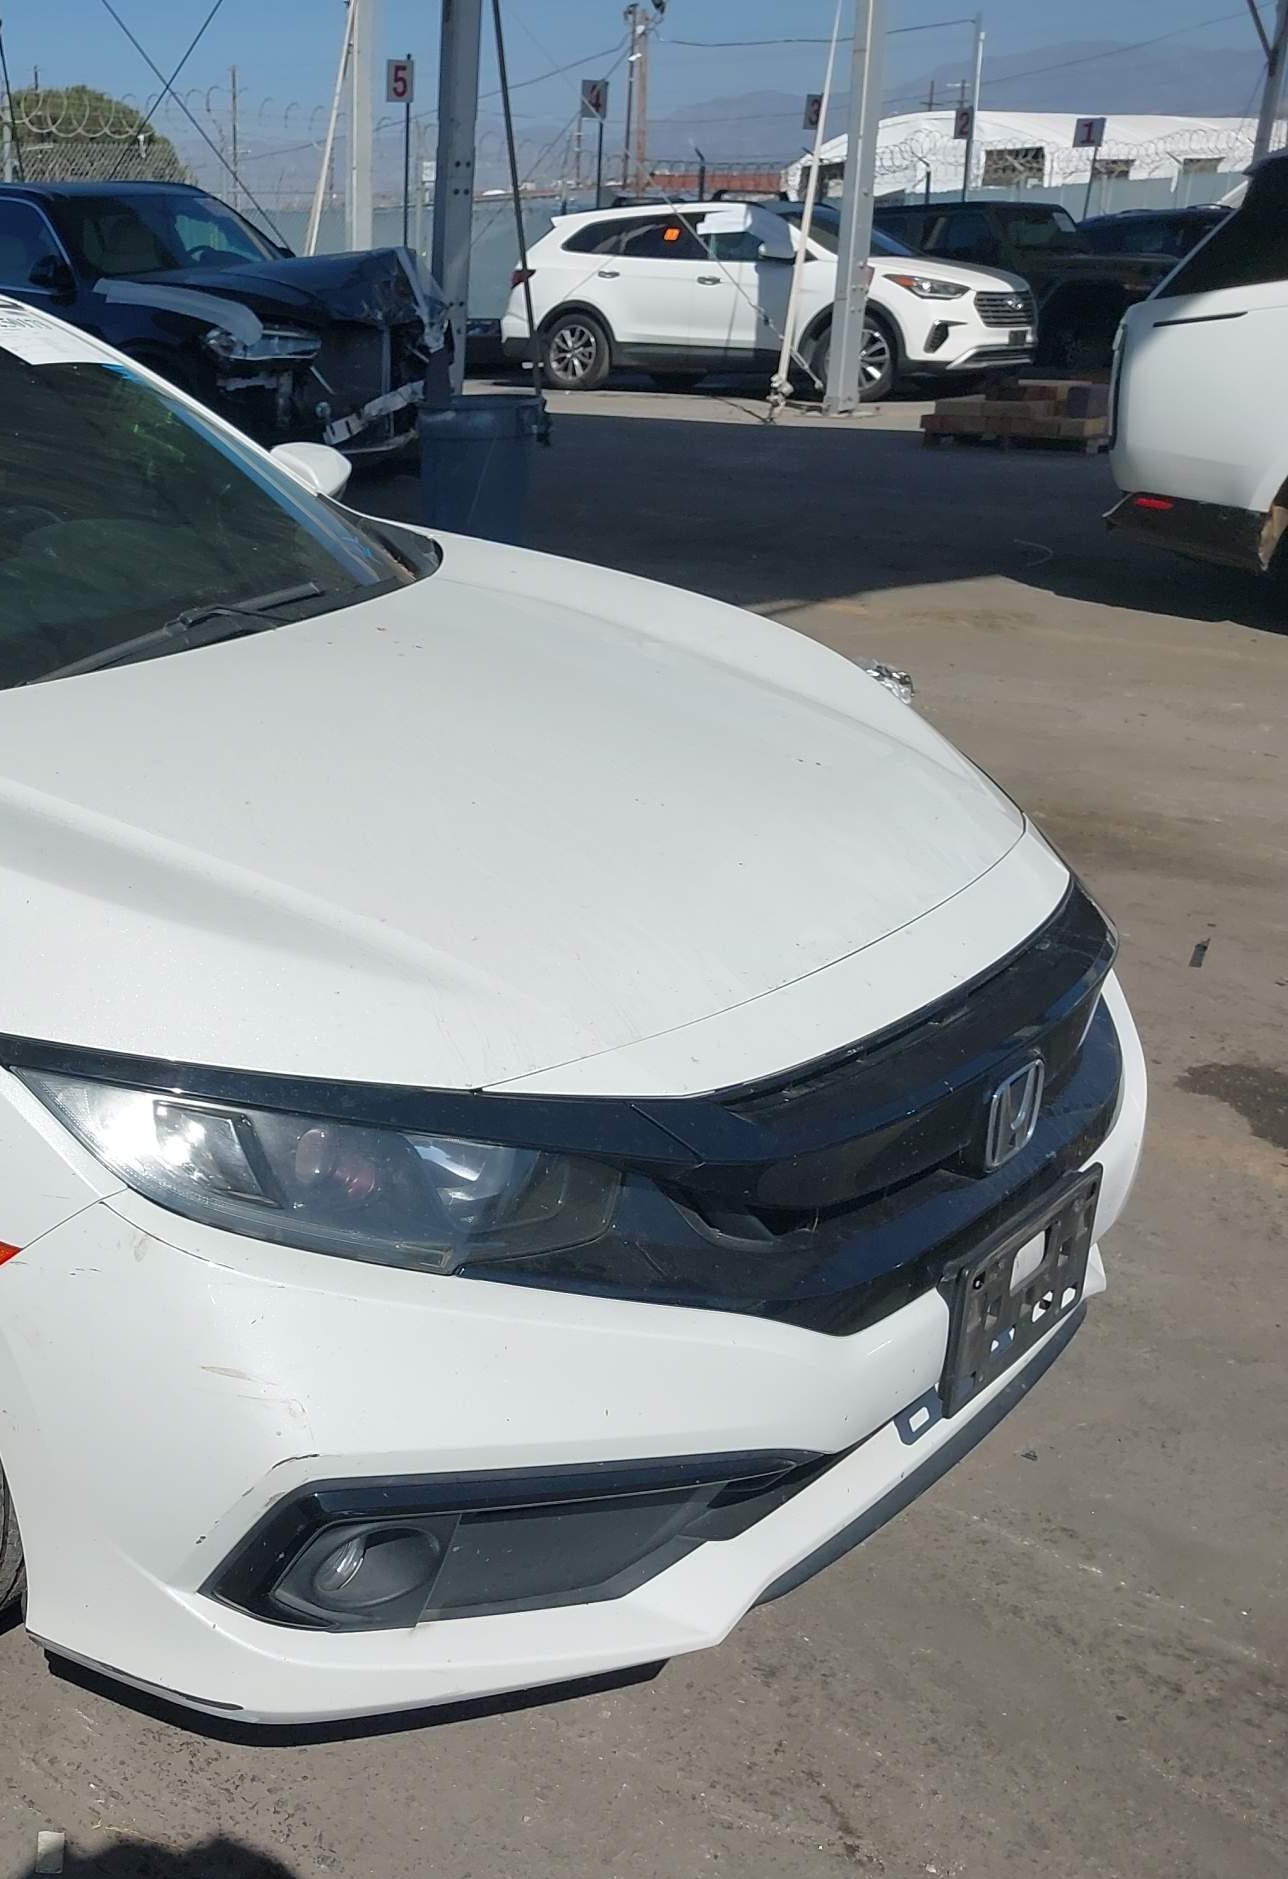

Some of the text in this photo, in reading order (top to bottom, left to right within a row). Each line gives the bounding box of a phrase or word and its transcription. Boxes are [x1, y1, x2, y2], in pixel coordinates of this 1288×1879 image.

[393, 64, 407, 97] 5
[588, 84, 601, 112] 4
[808, 98, 821, 126] 3
[959, 111, 970, 136] 2
[1079, 121, 1096, 144] 1
